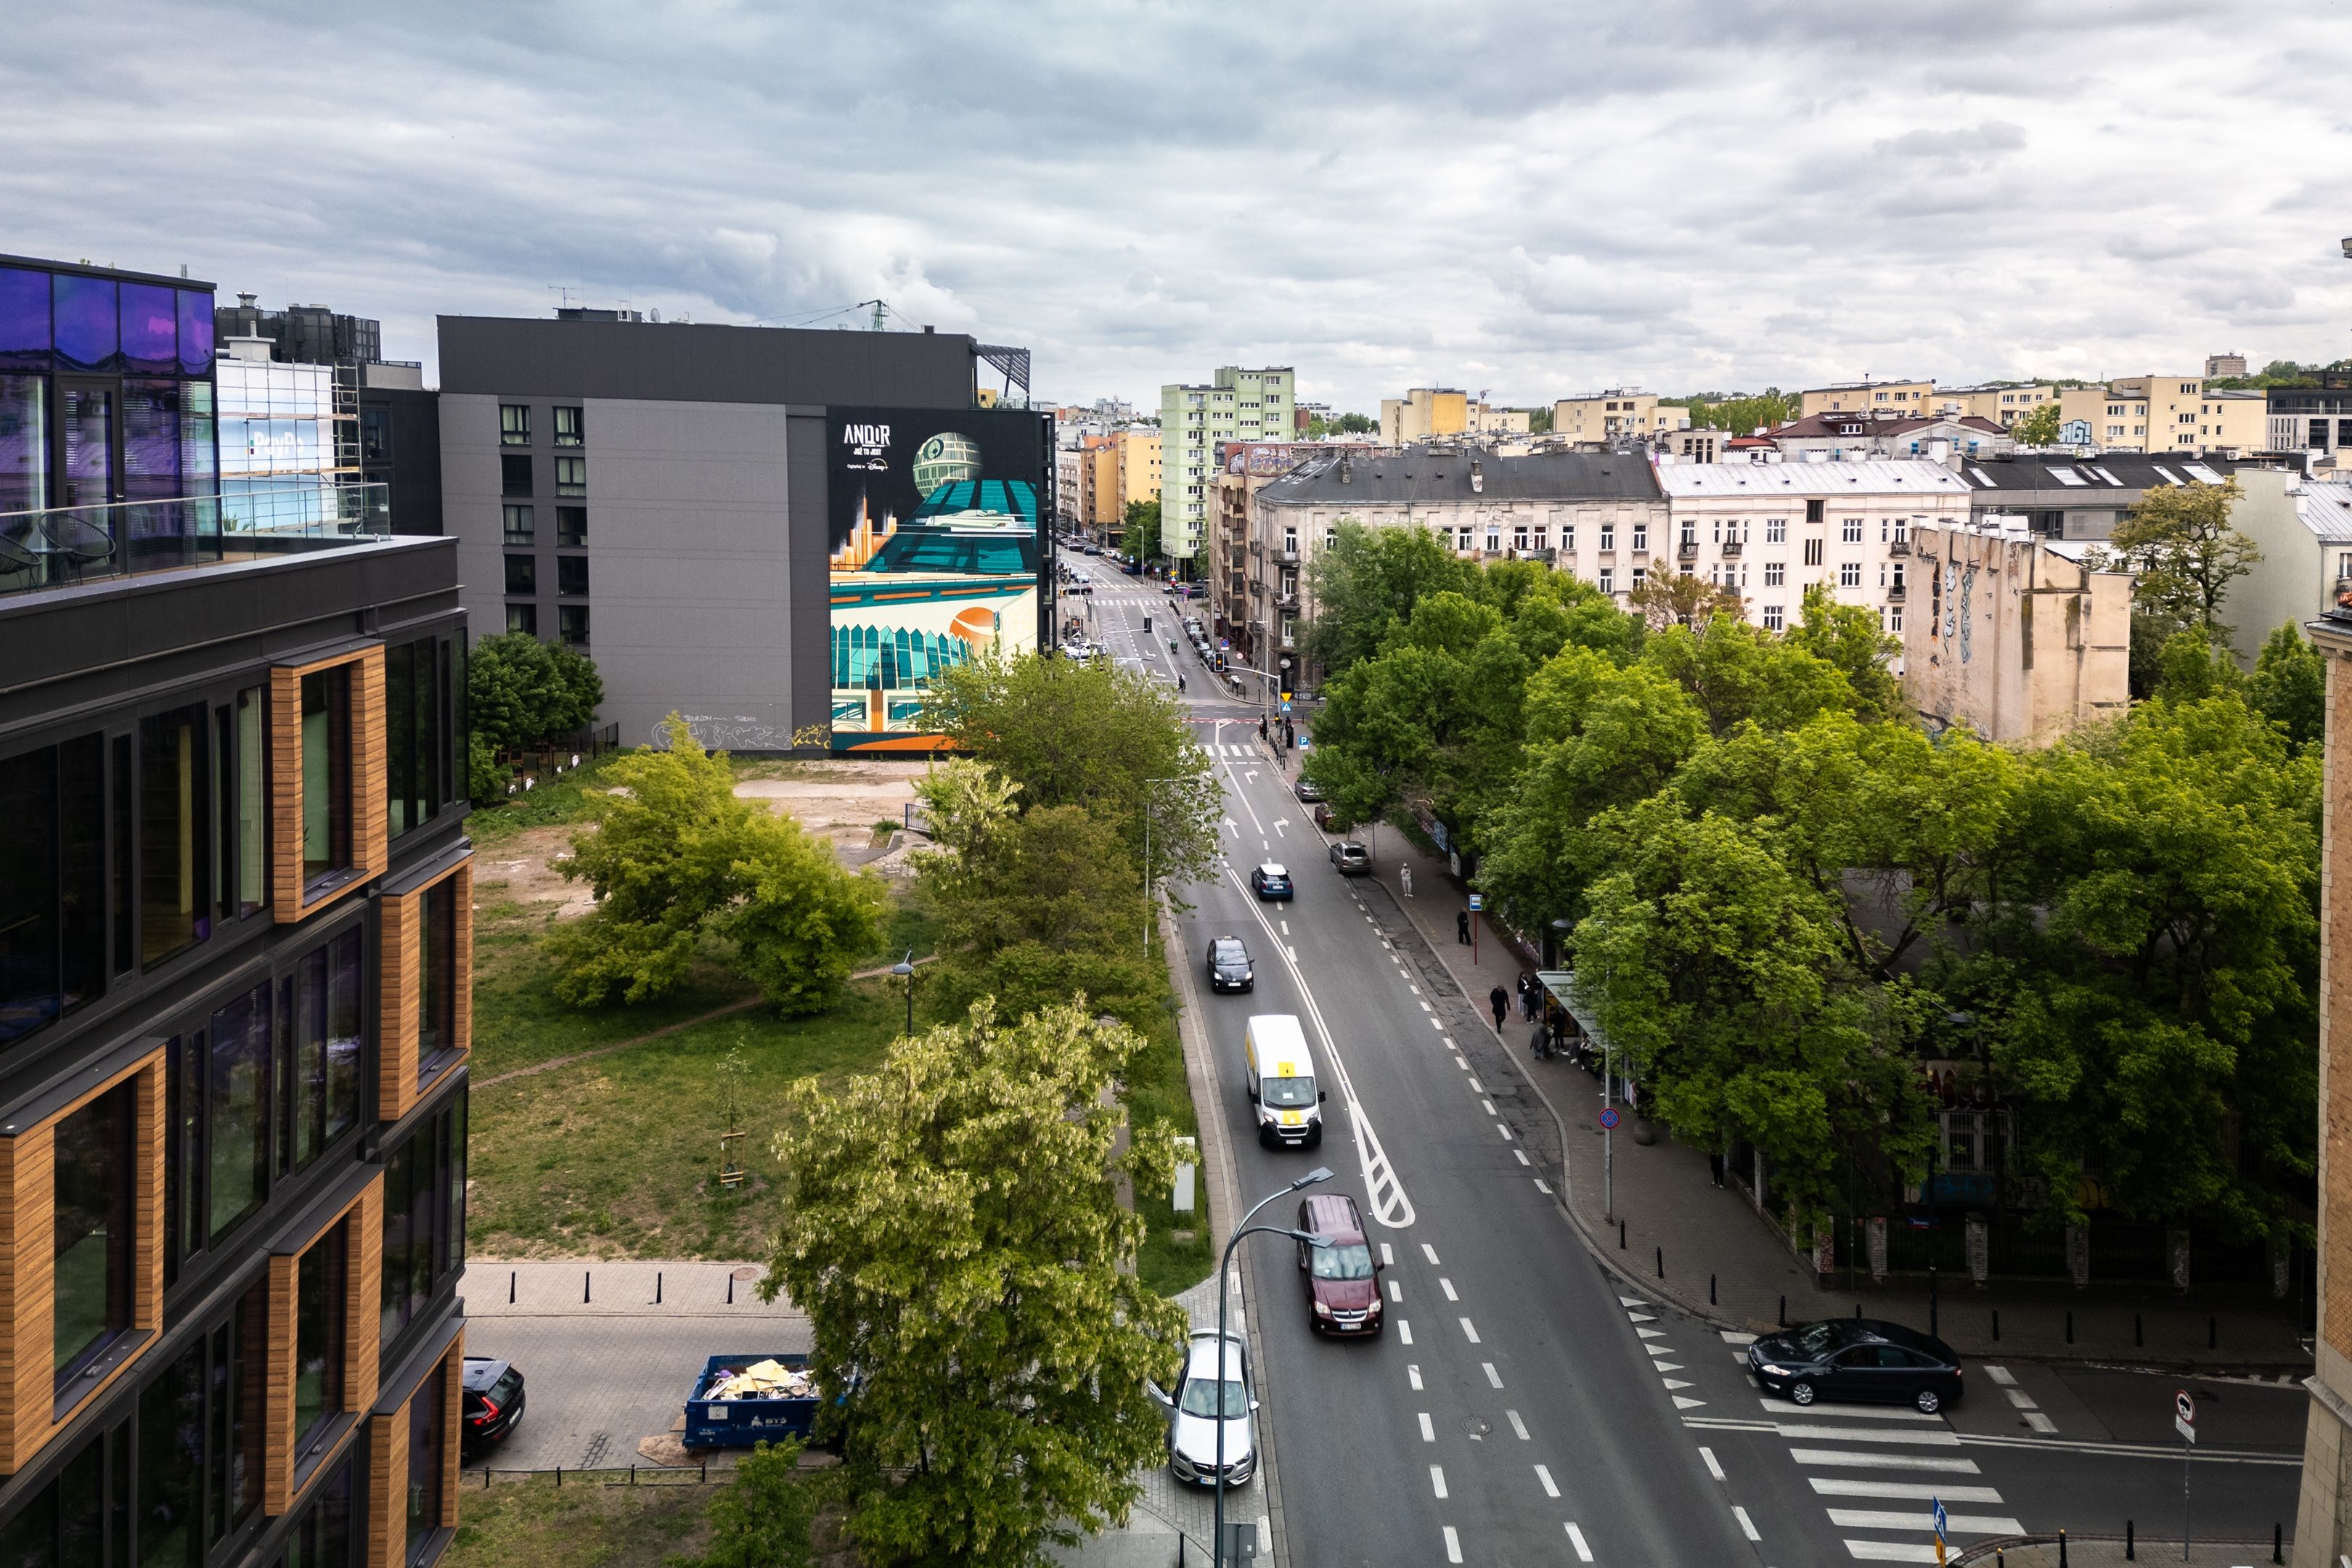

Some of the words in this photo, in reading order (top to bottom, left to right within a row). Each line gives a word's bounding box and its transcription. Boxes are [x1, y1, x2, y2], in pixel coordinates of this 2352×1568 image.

[253, 431, 304, 459] PayPo
[844, 424, 891, 446] ANDOR
[1301, 736, 1307, 745] P
